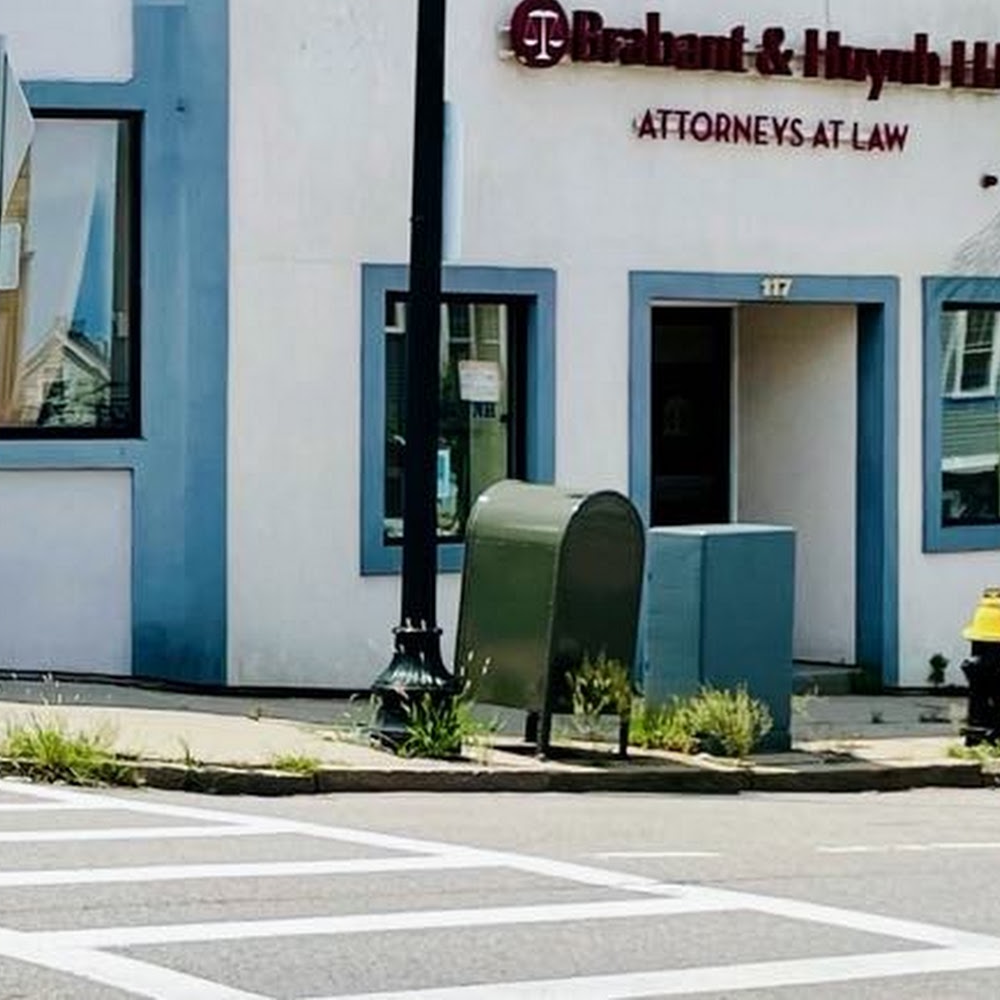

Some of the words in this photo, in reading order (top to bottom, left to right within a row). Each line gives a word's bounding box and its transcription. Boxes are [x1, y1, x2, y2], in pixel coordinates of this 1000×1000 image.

[571, 9, 748, 74] Brabant
[756, 27, 794, 77] &
[802, 28, 941, 101] Huynh
[951, 39, 1000, 89] LL
[637, 109, 804, 148] ATTORNEYS
[811, 120, 845, 150] AT
[852, 122, 909, 153] LAW
[761, 278, 792, 296] 117
